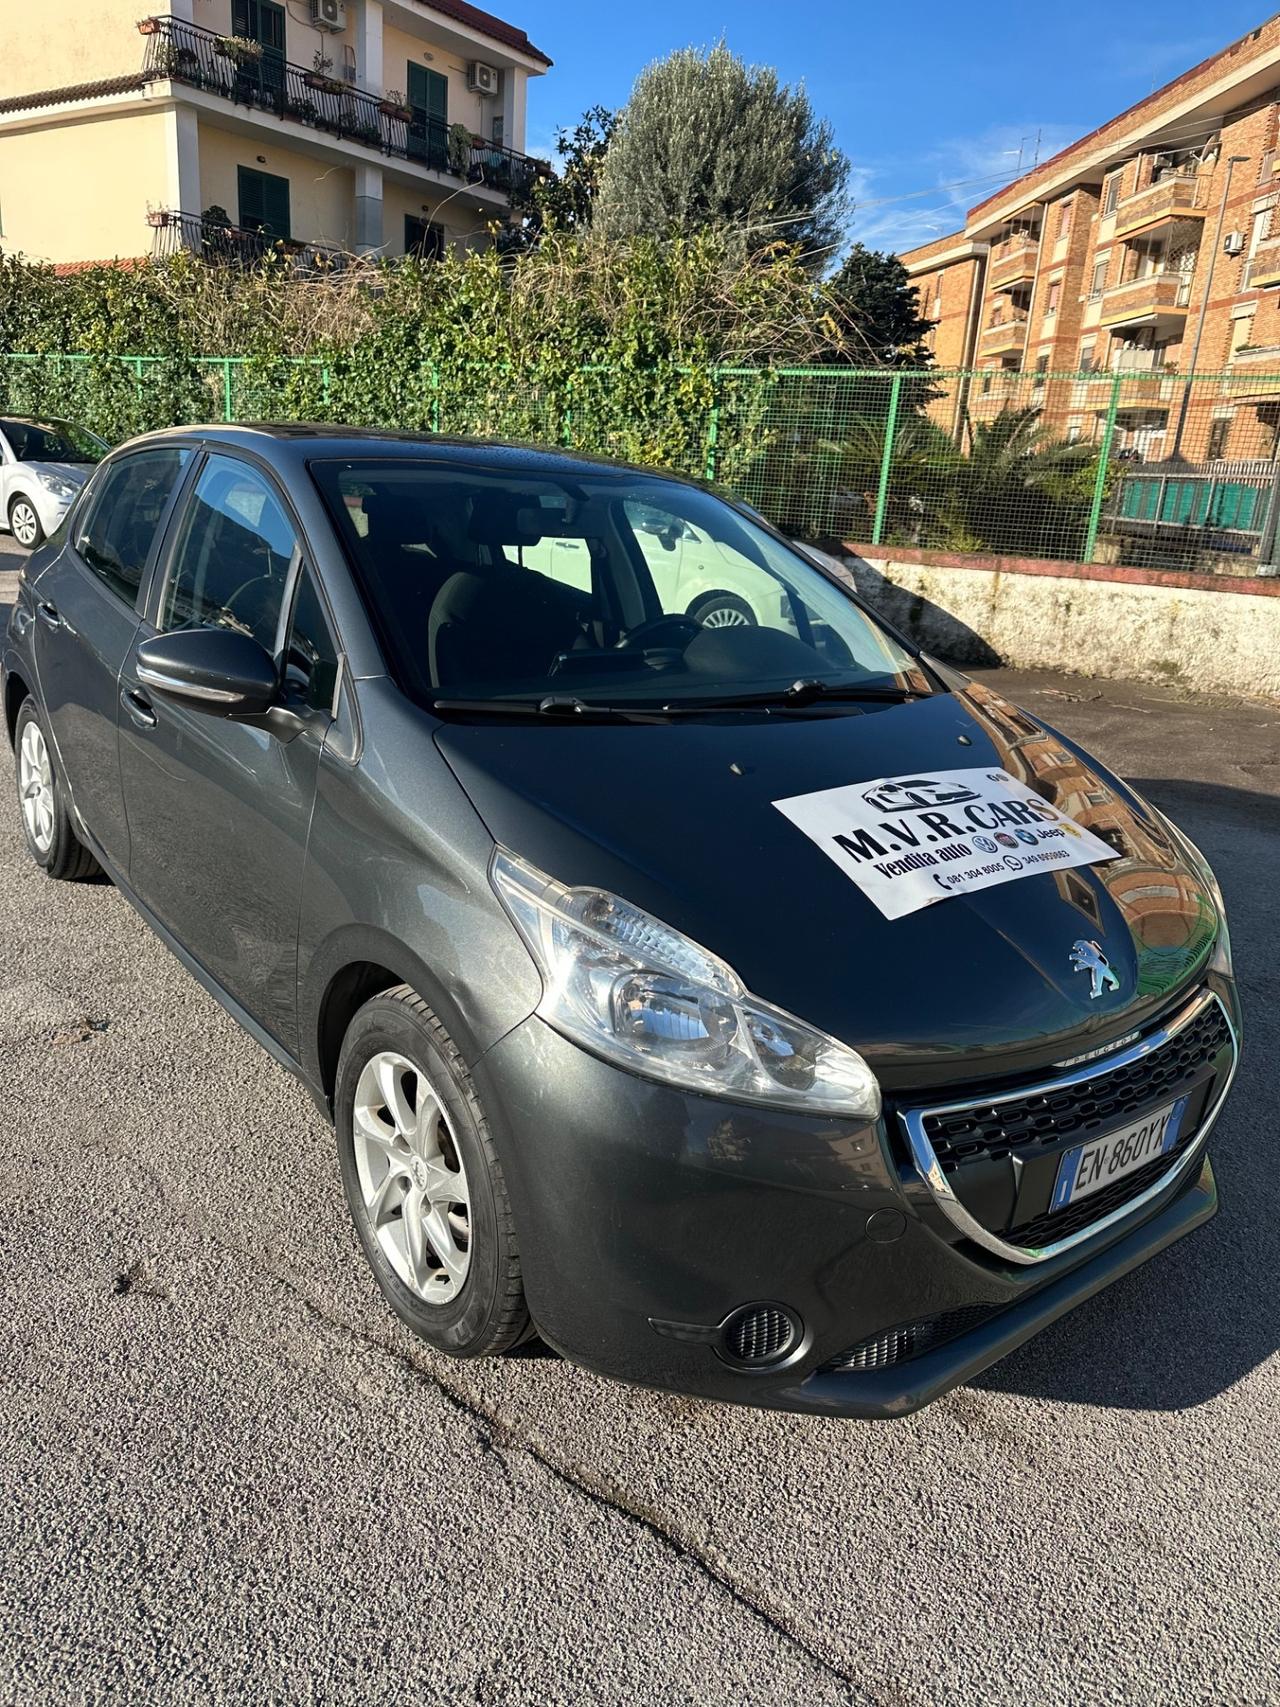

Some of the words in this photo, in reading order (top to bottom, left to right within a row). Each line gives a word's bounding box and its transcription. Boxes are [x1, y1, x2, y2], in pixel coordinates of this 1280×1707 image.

[1036, 827, 1066, 839] Jeep
[873, 851, 940, 879] Vendita
[935, 843, 972, 862] auto
[947, 873, 966, 884] 081
[967, 868, 984, 880] 304
[981, 862, 1005, 875] 8005
[1072, 1034, 1134, 1064] PEUGEOT
[1075, 1144, 1108, 1190] EN
[1108, 1113, 1171, 1174] 860YX
